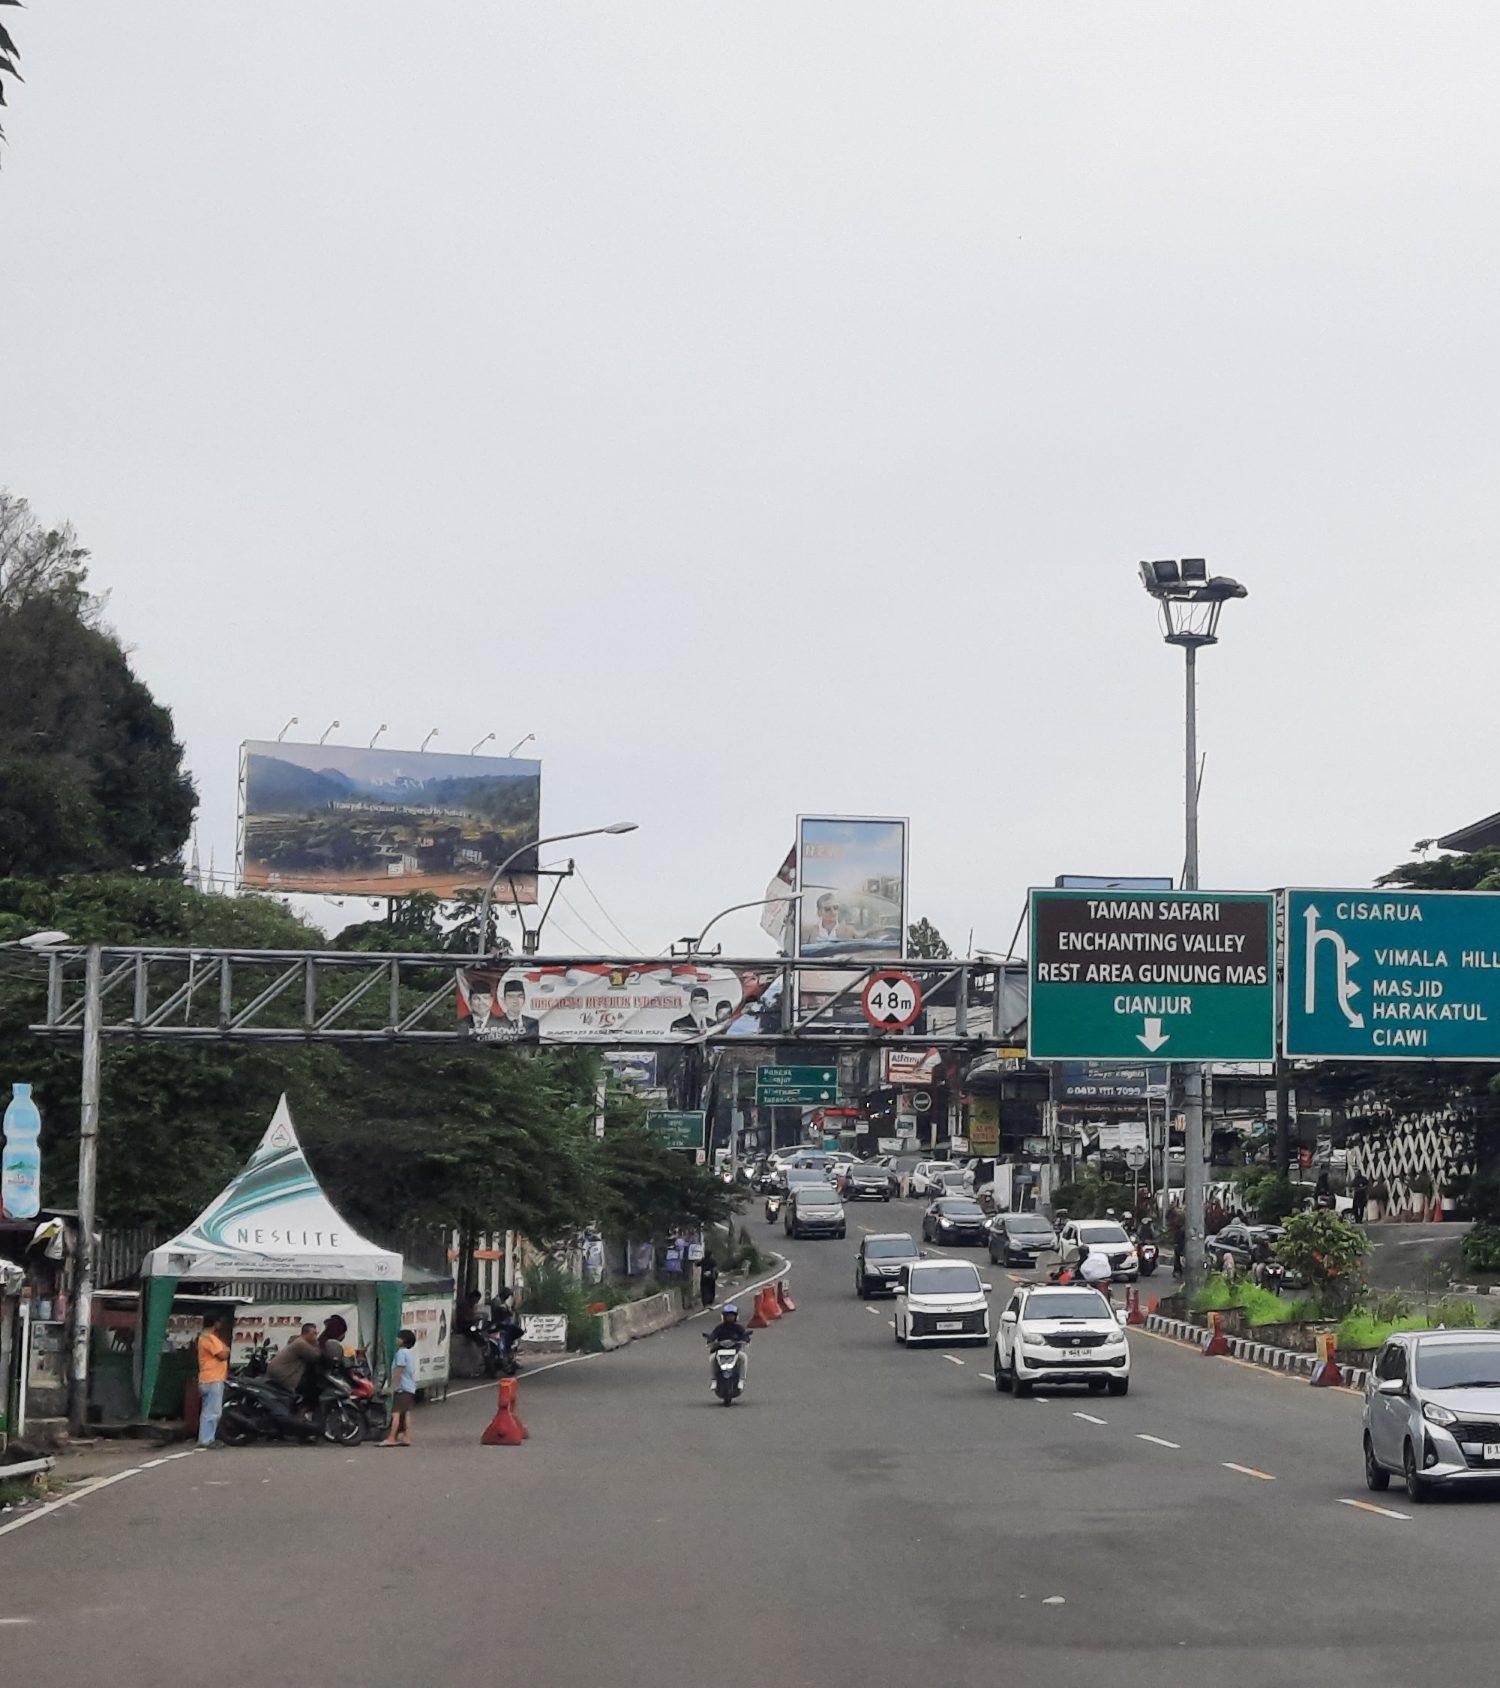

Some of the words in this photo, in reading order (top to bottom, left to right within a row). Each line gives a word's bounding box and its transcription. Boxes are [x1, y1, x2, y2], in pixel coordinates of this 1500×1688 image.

[1087, 901, 1153, 920] TAMAN
[1158, 901, 1220, 921] SAFARI
[1336, 903, 1423, 921] CISARUA
[1058, 932, 1177, 952] ENCHANTING
[1182, 934, 1246, 953] VALLEY
[1374, 949, 1448, 967] VIMALA
[1038, 963, 1081, 982] REST
[1085, 963, 1134, 982] AREA
[1138, 964, 1221, 983] GUNUNG
[1225, 966, 1267, 984] MAS
[1373, 980, 1443, 997] MASJID
[1114, 996, 1192, 1014] CIANJUR
[1372, 1003, 1488, 1021] HARAKATUL
[1372, 1029, 1427, 1047] CIAWI
[237, 1228, 340, 1248] NESLITE
